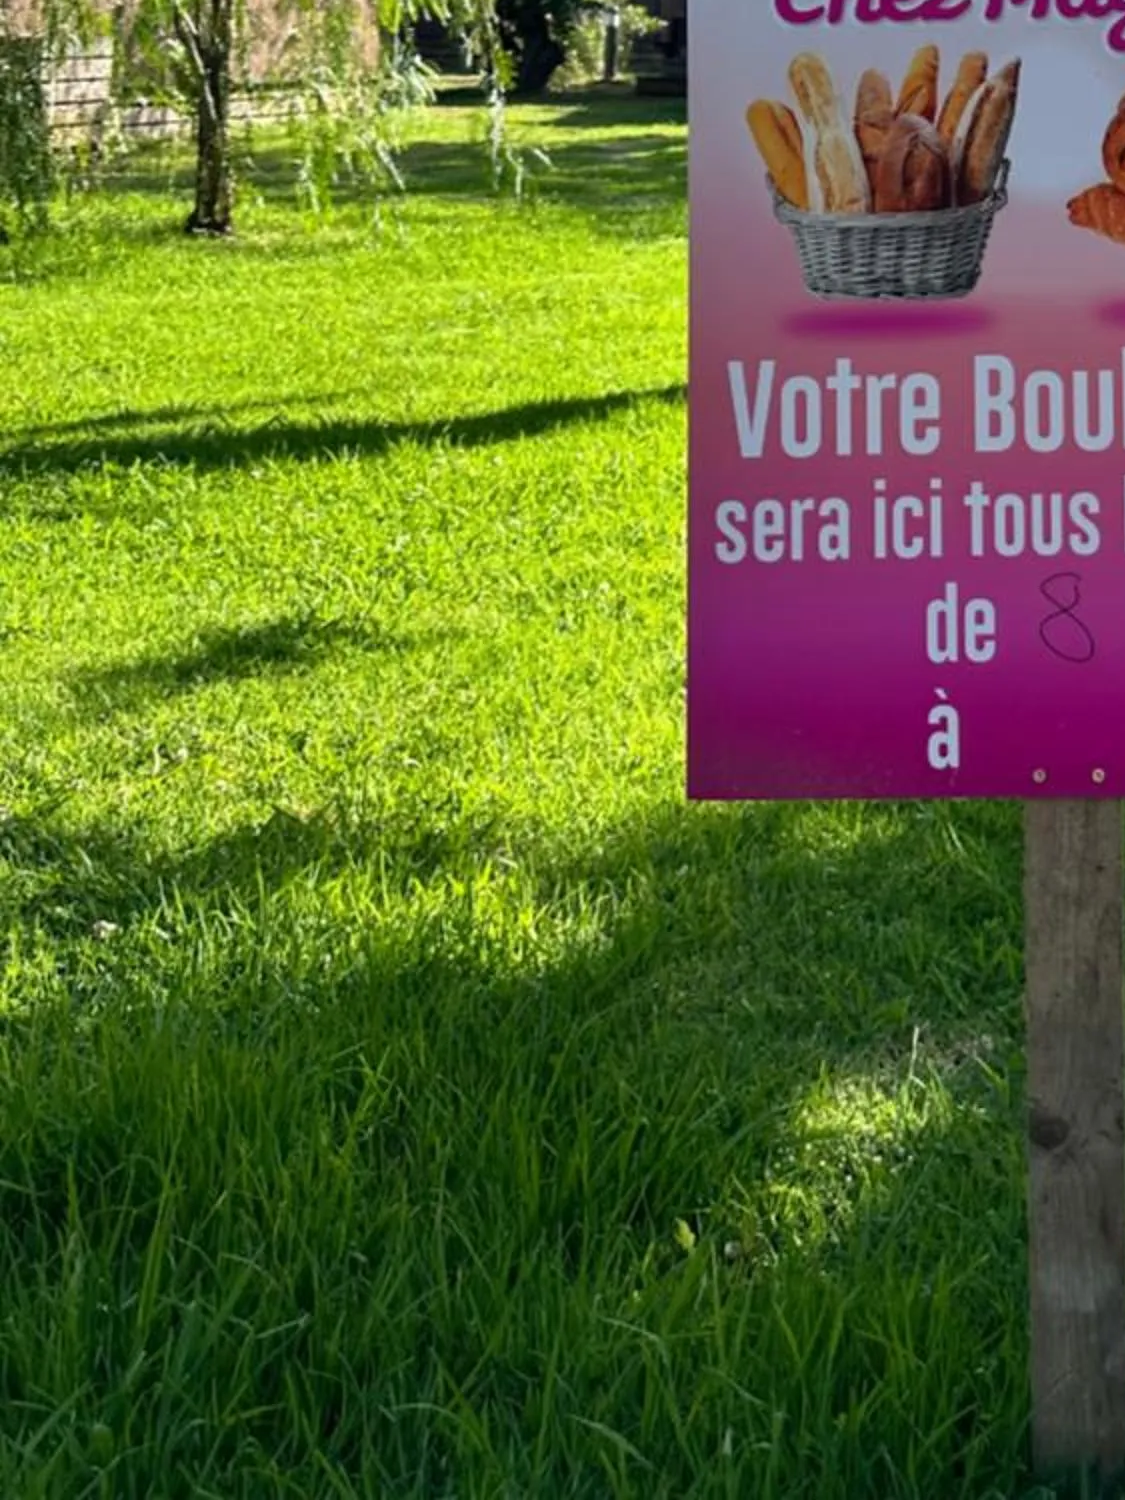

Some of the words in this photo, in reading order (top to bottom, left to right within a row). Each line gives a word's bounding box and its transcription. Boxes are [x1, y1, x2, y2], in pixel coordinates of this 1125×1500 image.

[727, 358, 940, 458] Votre
[715, 495, 850, 563] sera
[873, 479, 942, 558] ici
[965, 481, 1100, 557] tous
[926, 582, 997, 664] de
[1038, 571, 1095, 663] 8
[926, 689, 960, 770] à
